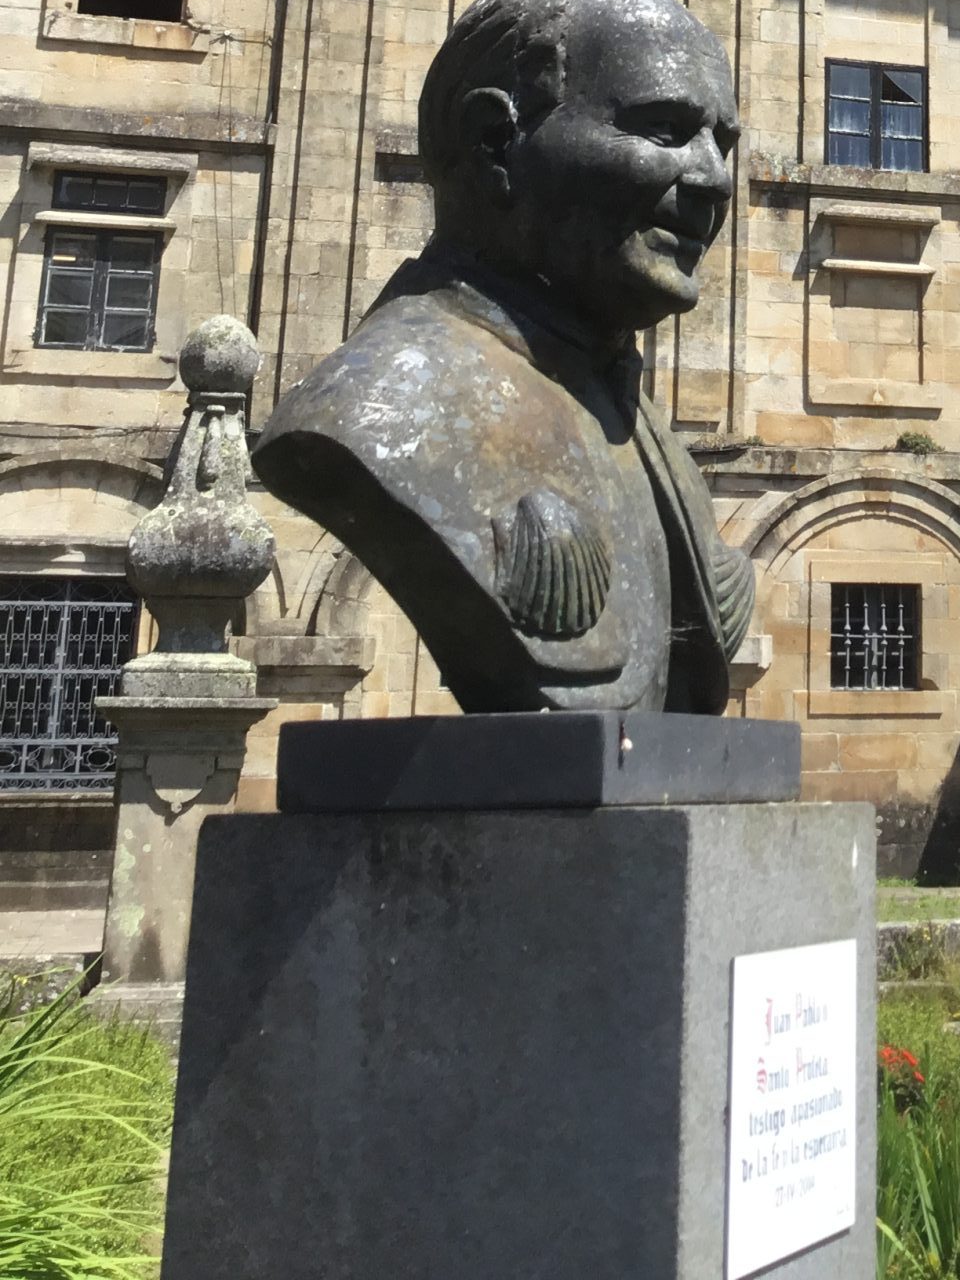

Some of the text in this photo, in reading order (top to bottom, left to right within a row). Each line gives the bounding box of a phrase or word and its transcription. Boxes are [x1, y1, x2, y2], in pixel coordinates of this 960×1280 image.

[764, 998, 792, 1047] Juan
[795, 992, 821, 1028] Pablo
[756, 1047, 829, 1094] Santo Profeta
[749, 1086, 842, 1137] testigo apasionado
